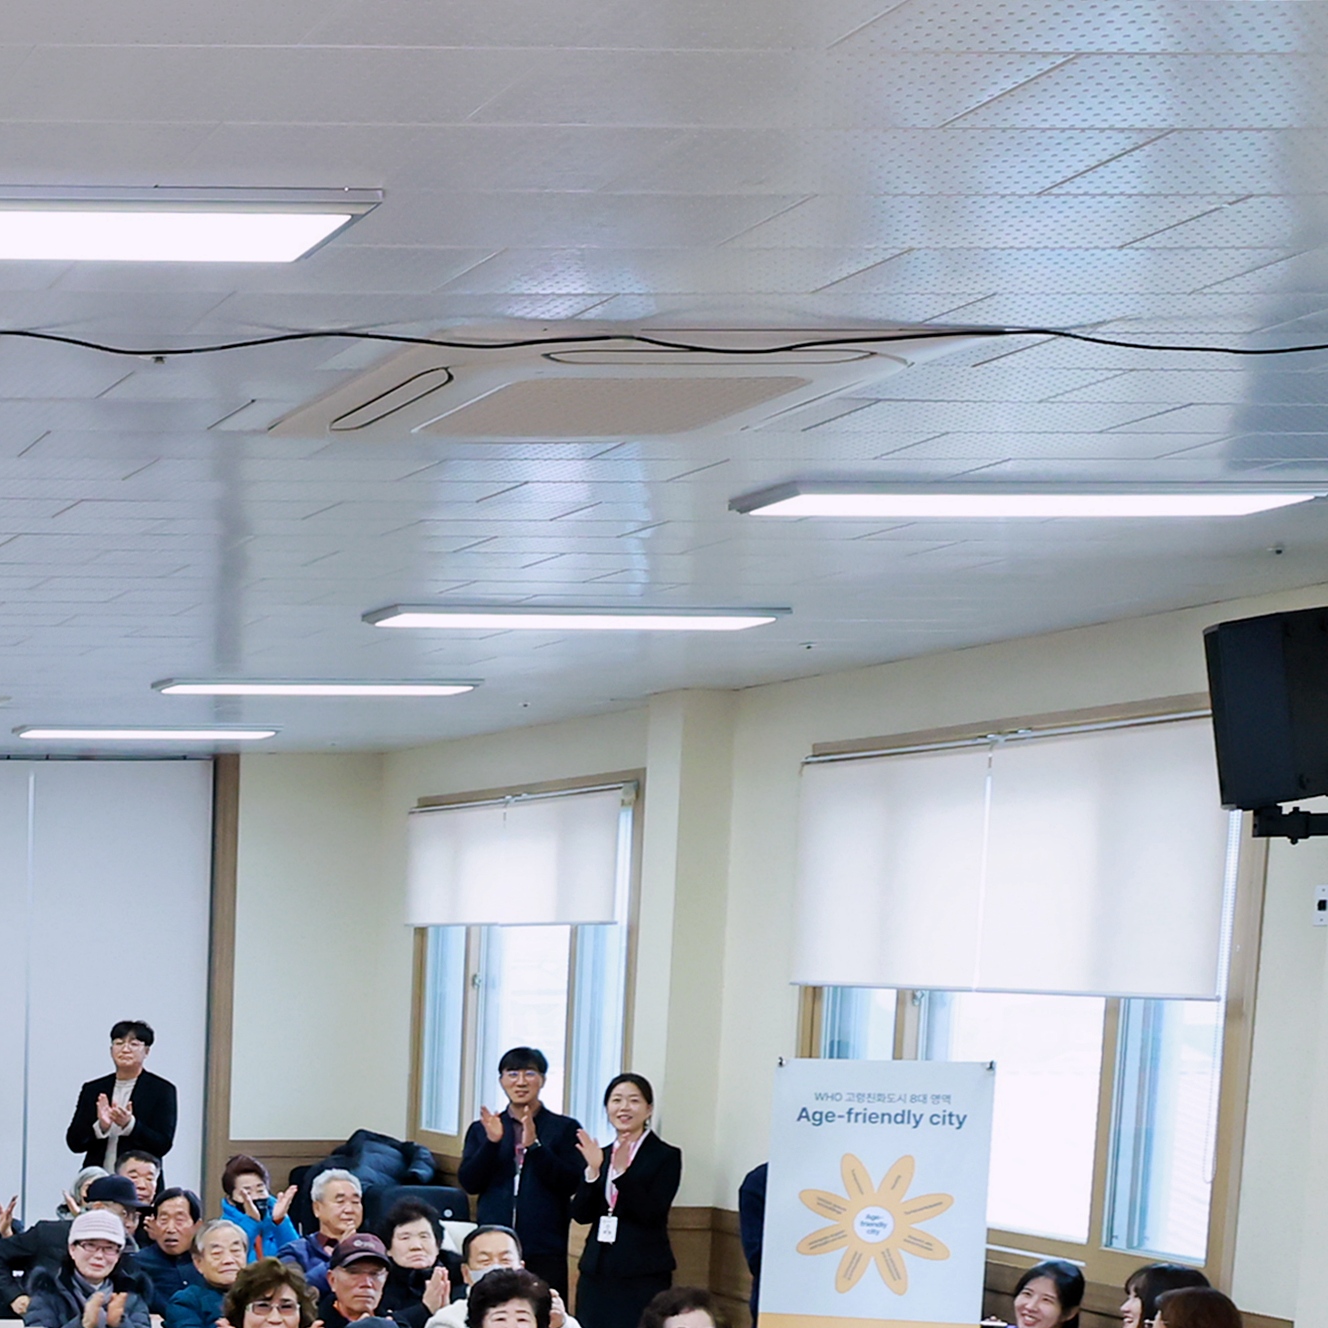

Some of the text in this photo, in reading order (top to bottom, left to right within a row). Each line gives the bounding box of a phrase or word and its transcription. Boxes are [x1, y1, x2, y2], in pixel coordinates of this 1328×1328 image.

[814, 1092, 842, 1102] WHO
[846, 1092, 907, 1104] 고령친화도시
[909, 1094, 928, 1104] 8대
[796, 1107, 968, 1130] Age-friendly city
[865, 1214, 884, 1222] Age-
[860, 1221, 888, 1229] friendly
[866, 1228, 881, 1236] city
